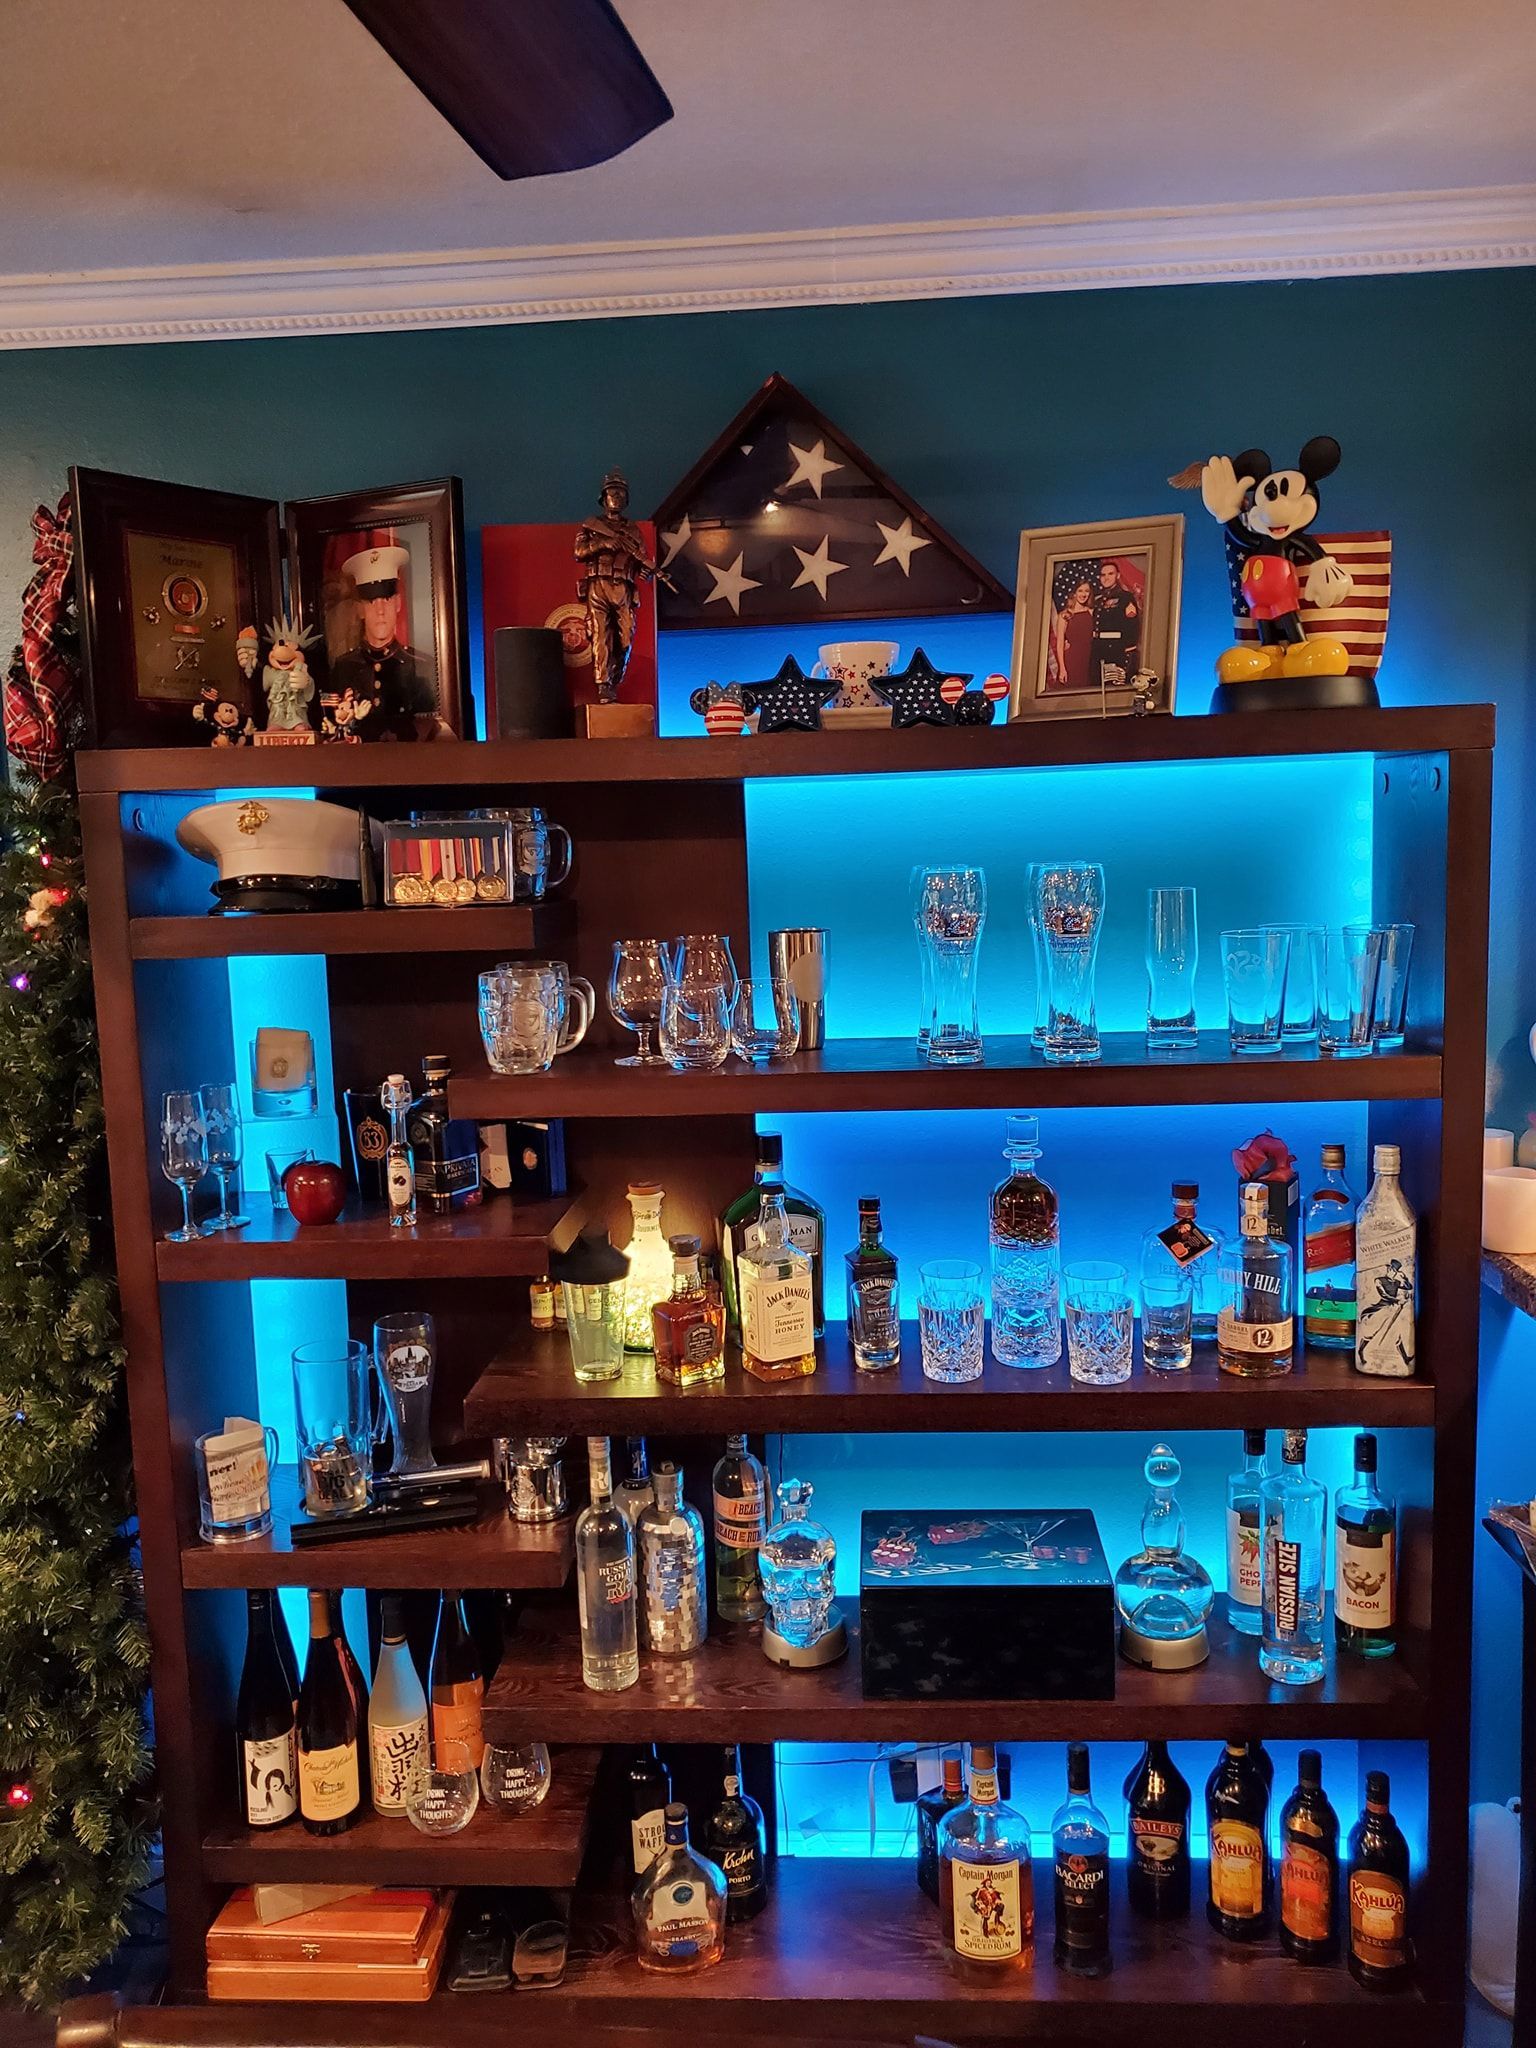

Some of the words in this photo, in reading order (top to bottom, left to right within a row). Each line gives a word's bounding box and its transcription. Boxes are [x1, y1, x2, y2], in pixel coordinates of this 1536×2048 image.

[1246, 1217, 1257, 1230] 12
[1359, 1242, 1382, 1254] WHITE
[1382, 1234, 1411, 1248] WALKER
[861, 1282, 875, 1293] JACK
[1253, 1273, 1282, 1295] HILL
[766, 1290, 785, 1308] JACK
[784, 1286, 811, 1301] DANIEL'S
[774, 1316, 805, 1328] Tennessee
[774, 1323, 806, 1335] HONEY
[1256, 1328, 1272, 1346] 12
[1279, 1541, 1297, 1574] SIZE
[1279, 1575, 1297, 1631] RUSSIAN
[1346, 1597, 1380, 1609] BACON
[506, 1767, 526, 1778] DRINK
[505, 1778, 527, 1789] HAPPY
[975, 1780, 995, 1791] Captain
[426, 1789, 446, 1799] DRINK
[499, 1787, 534, 1799] THOUGHTS
[976, 1789, 995, 1798] Morgan
[424, 1799, 447, 1809] HAPPY
[419, 1809, 453, 1820] THOUGHTS
[1132, 1820, 1180, 1835] BAILEYS
[639, 1836, 663, 1849] WAFF
[722, 1849, 755, 1870] Krohn
[1138, 1861, 1176, 1872] ORIGINAL
[728, 1875, 751, 1884] PORTO
[959, 1866, 986, 1881] Captain
[986, 1869, 1014, 1882] Morgan
[1055, 1864, 1104, 1884] BACARDI
[1064, 1880, 1096, 1890] SELECT
[656, 1923, 678, 1933] PAUL
[678, 1918, 710, 1929] MASSON
[671, 1934, 697, 1942] BRANDY
[964, 1938, 993, 1950] SPICED
[993, 1940, 1012, 1951] RUM
